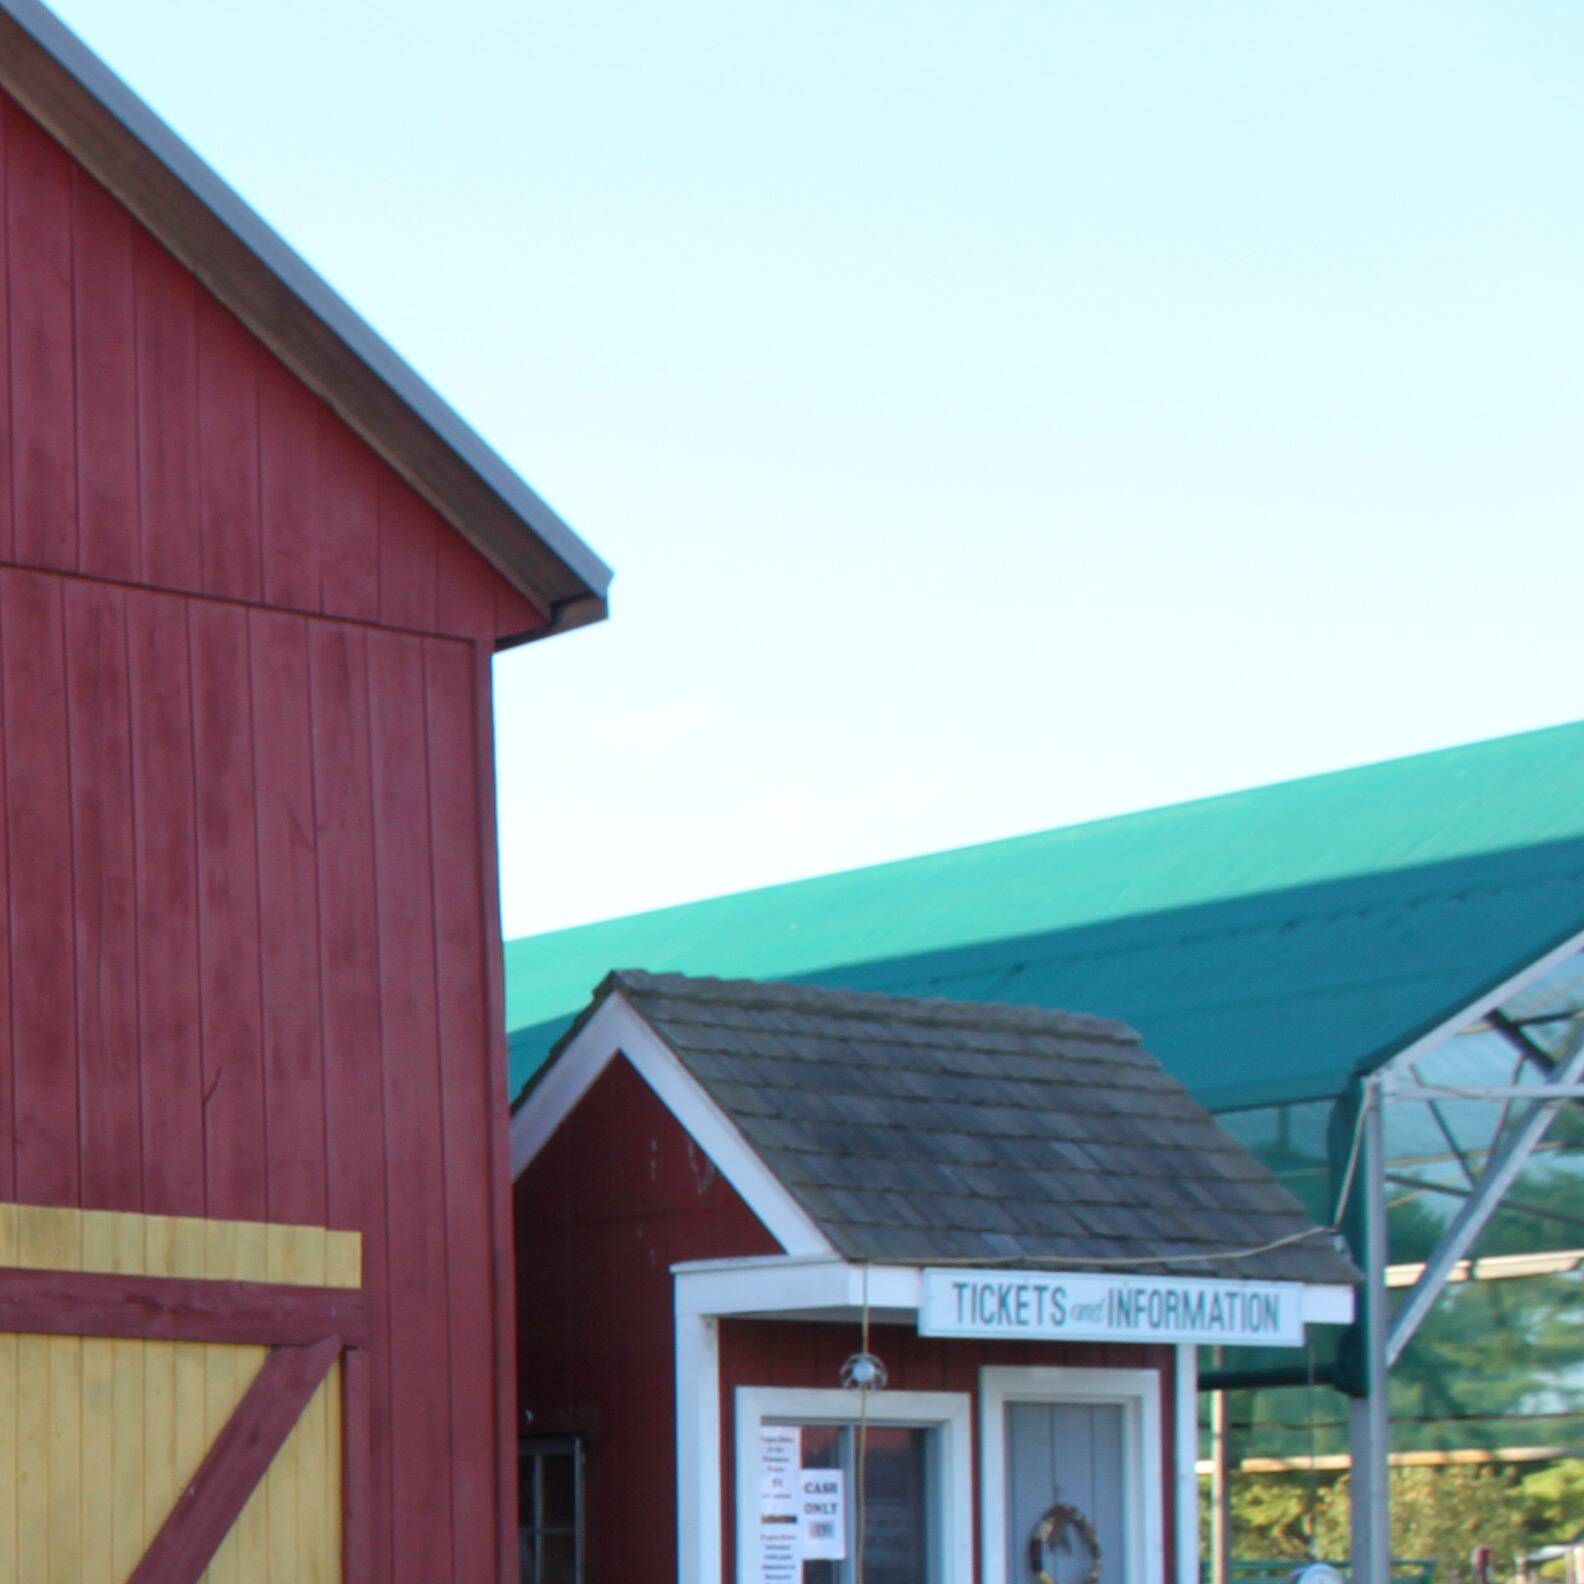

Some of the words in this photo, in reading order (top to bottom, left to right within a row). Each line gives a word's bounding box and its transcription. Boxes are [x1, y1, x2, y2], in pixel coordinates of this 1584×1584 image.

[952, 1282, 1067, 1327] TICKETS
[1106, 1287, 1280, 1333] INFORMATION
[803, 1481, 838, 1494] CASH
[803, 1502, 838, 1515] ONLY
